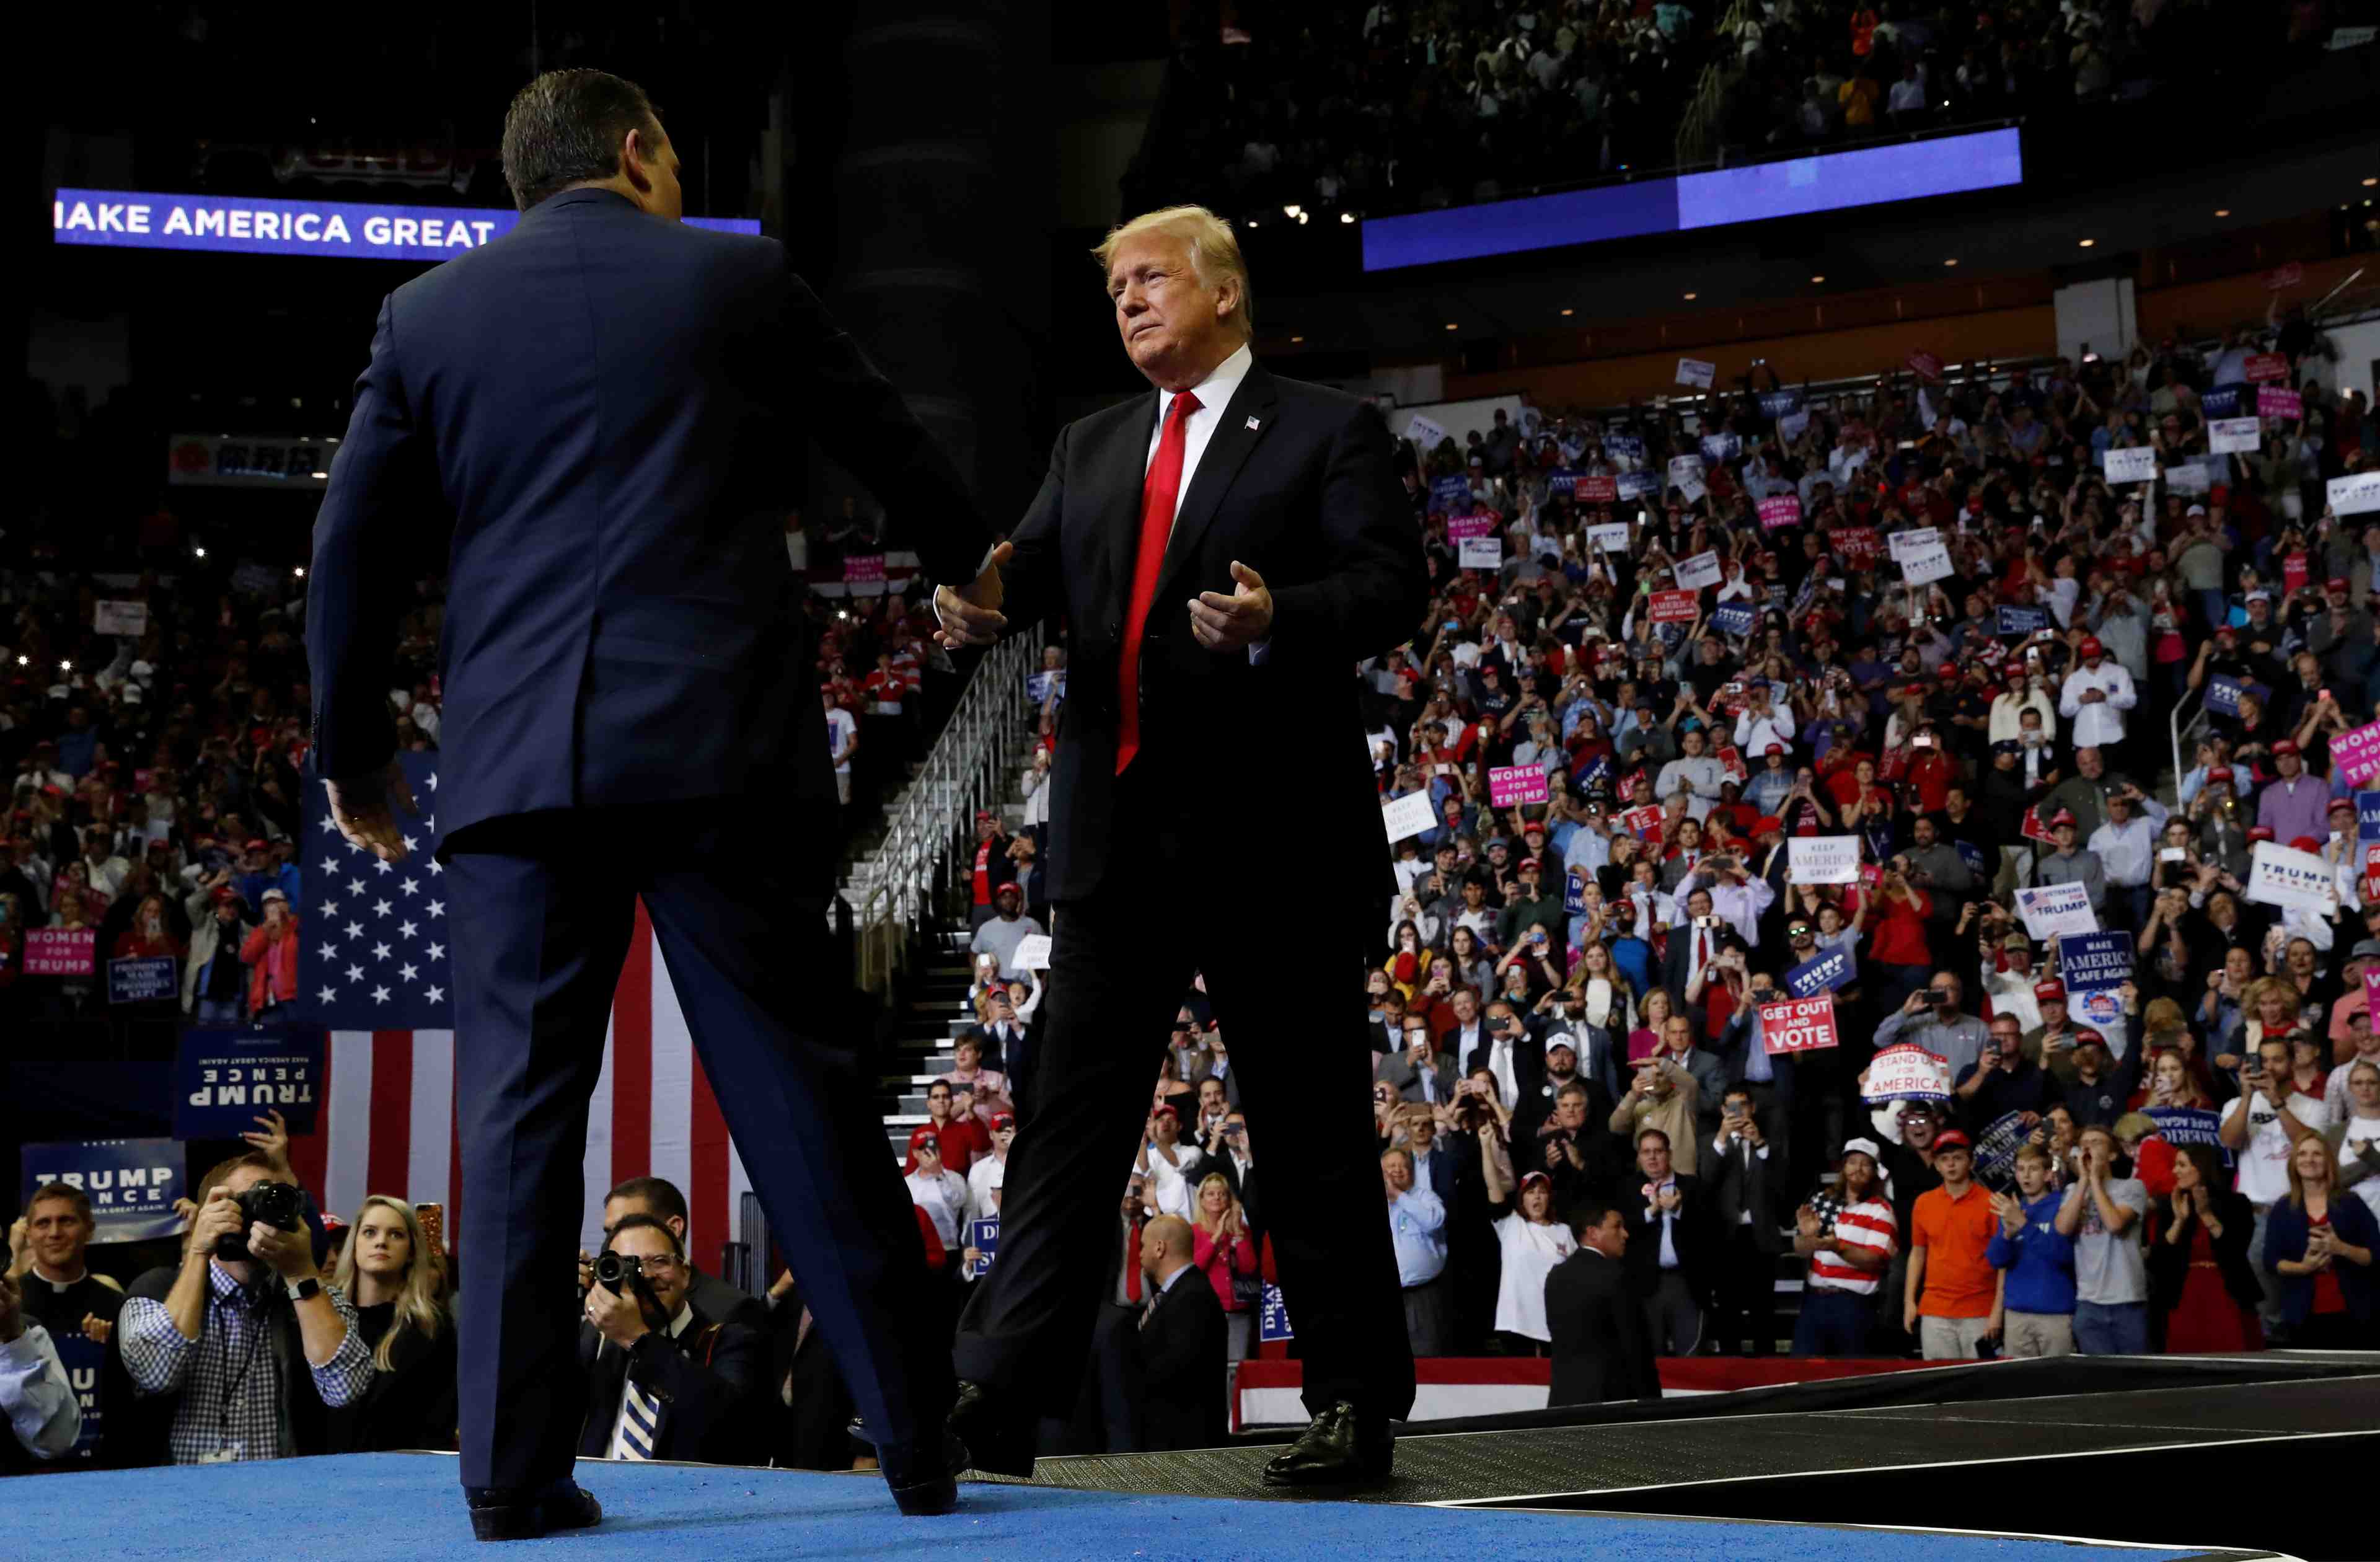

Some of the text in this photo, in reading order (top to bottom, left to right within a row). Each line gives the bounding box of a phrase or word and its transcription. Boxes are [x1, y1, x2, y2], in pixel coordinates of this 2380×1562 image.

[54, 201, 495, 249] AKE AMERICA GREAT
[2330, 723, 2380, 754] WOM
[1489, 766, 1545, 782] WOMEN
[1508, 782, 1528, 790] FOR
[1495, 788, 1544, 805] TRUMP
[1810, 844, 1835, 852] KEEP
[1794, 854, 1855, 865] AMERICA
[1809, 868, 1840, 877] GREAT
[2262, 862, 2330, 883] TRUMP
[2037, 901, 2087, 916] TRUMP
[25, 929, 95, 943] WOMEN
[2086, 940, 2113, 951] MAKE
[26, 960, 90, 972] TRUMP
[1794, 954, 1844, 989] TRUMP
[2074, 969, 2102, 983] SAFE
[1763, 1000, 1828, 1020] GET OUT
[1786, 1017, 1810, 1028] AND
[1768, 1024, 1831, 1049] VOTE
[1879, 1054, 1917, 1068] STAND
[203, 1067, 306, 1083] PENCE
[1873, 1077, 1942, 1093] AMERICA
[188, 1083, 312, 1107] TRUMP
[35, 1167, 174, 1191] TRUMP
[98, 1188, 162, 1205] NCE
[1265, 1284, 1276, 1330] DRA
